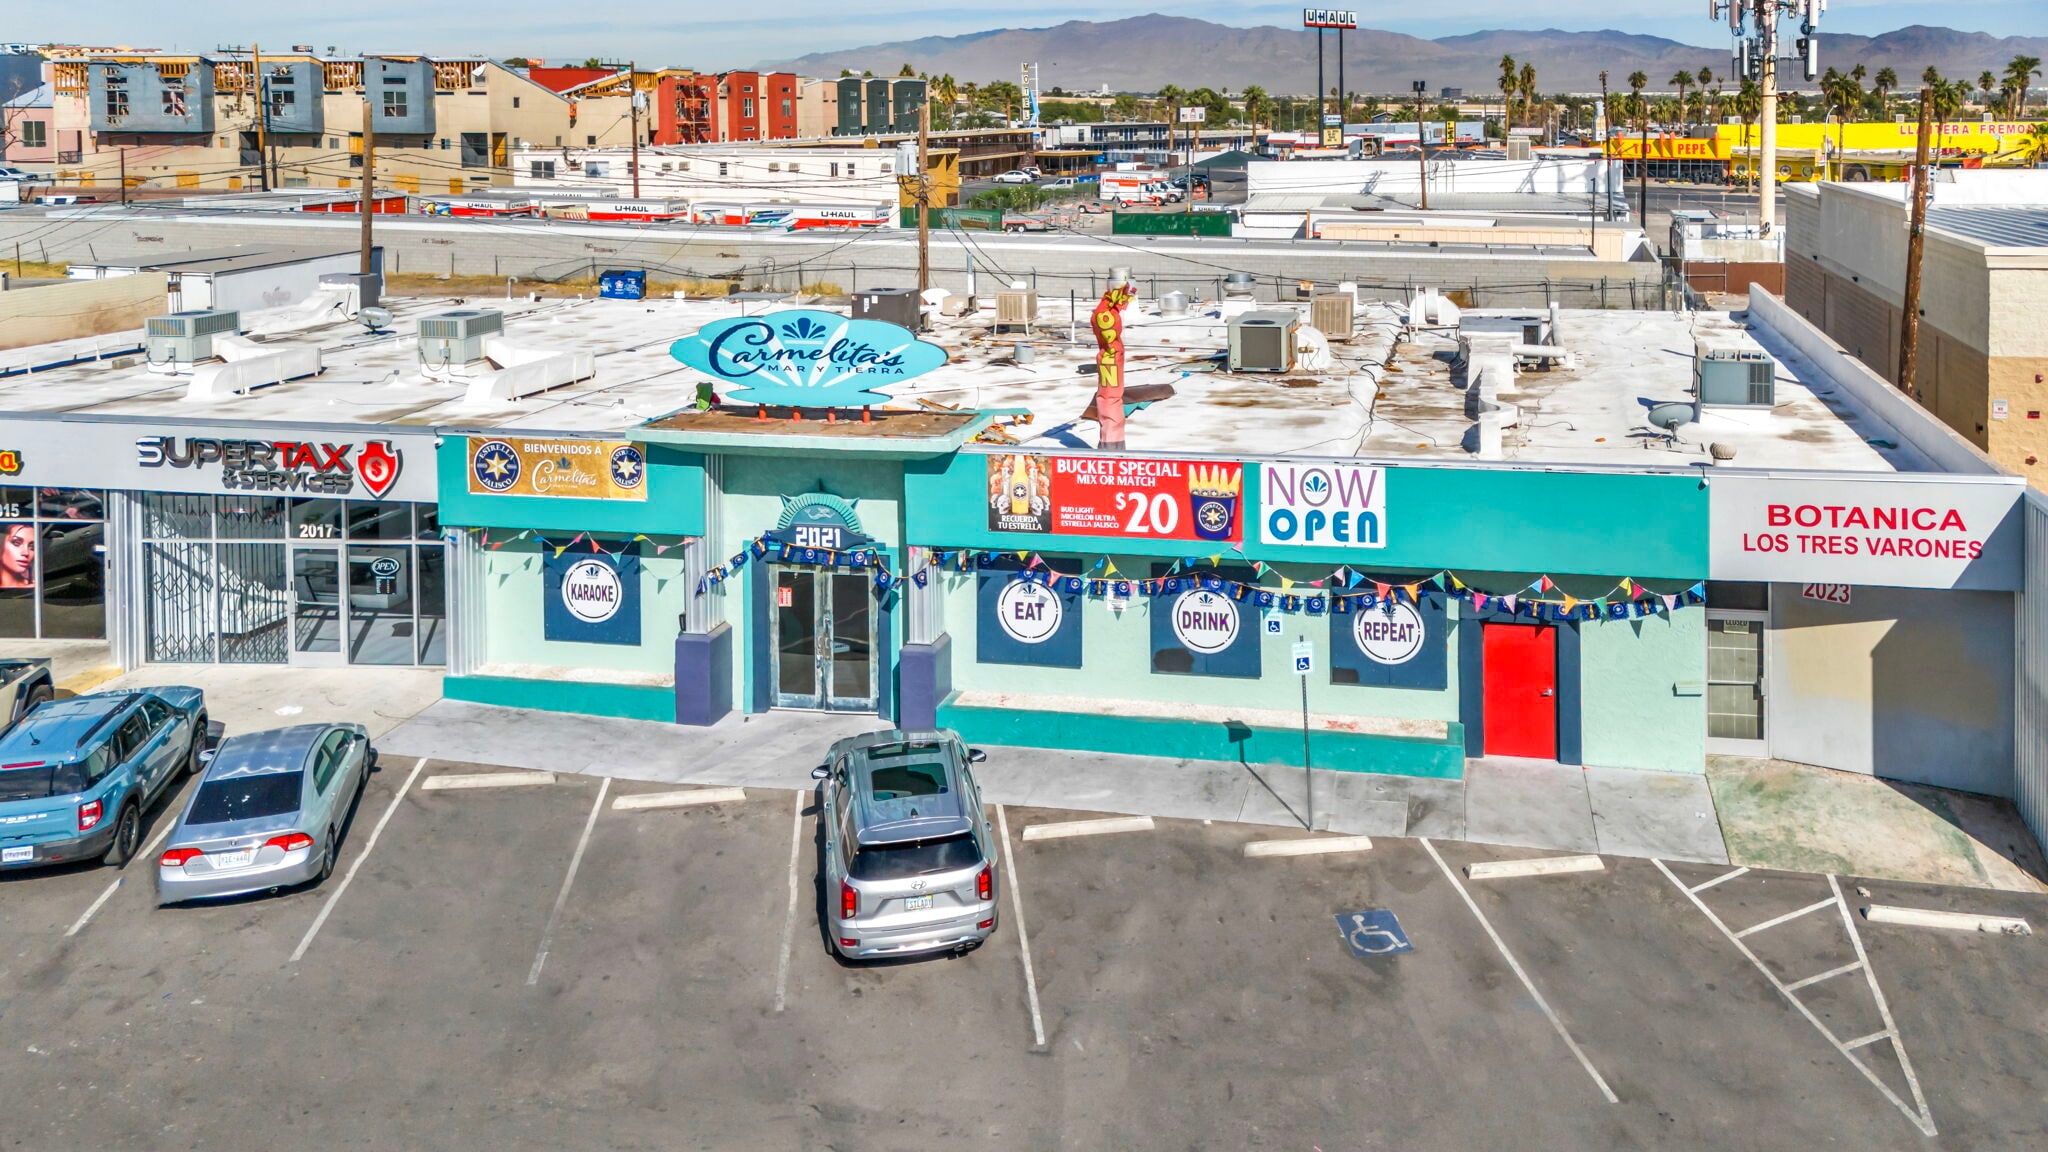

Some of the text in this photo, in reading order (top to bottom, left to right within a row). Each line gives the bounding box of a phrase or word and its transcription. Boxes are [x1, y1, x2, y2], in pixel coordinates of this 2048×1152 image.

[1900, 124, 1969, 134] LLTERA
[1677, 143, 1706, 155] PEPE
[708, 321, 905, 377] Carmelita's
[768, 365, 806, 373] MAR
[835, 366, 905, 375] TIERRA
[524, 443, 602, 455] BIENVENIDOS A
[479, 444, 515, 488] ESTRELLA JALISCO
[1056, 459, 1182, 477] BUCKET SPECIAL
[239, 471, 354, 494] SERVICES
[1077, 475, 1156, 487] MIX OR MATCH
[1268, 467, 1378, 508] NOW
[1001, 515, 1039, 523] RECUERDA
[1115, 491, 1179, 534] $20
[1767, 504, 1967, 532] BOTANICA
[299, 524, 334, 538] 2017
[1008, 522, 1042, 530] ESTRELLA
[795, 527, 840, 548] 2021
[1743, 533, 1983, 560] LOS TRES VARONES
[375, 562, 397, 570] OPEN
[570, 583, 614, 602] KARAOKE
[1803, 582, 1850, 603] 2023
[1014, 602, 1045, 621] EAT
[1182, 610, 1230, 632] DRINK
[1363, 621, 1415, 643] REPEAT
